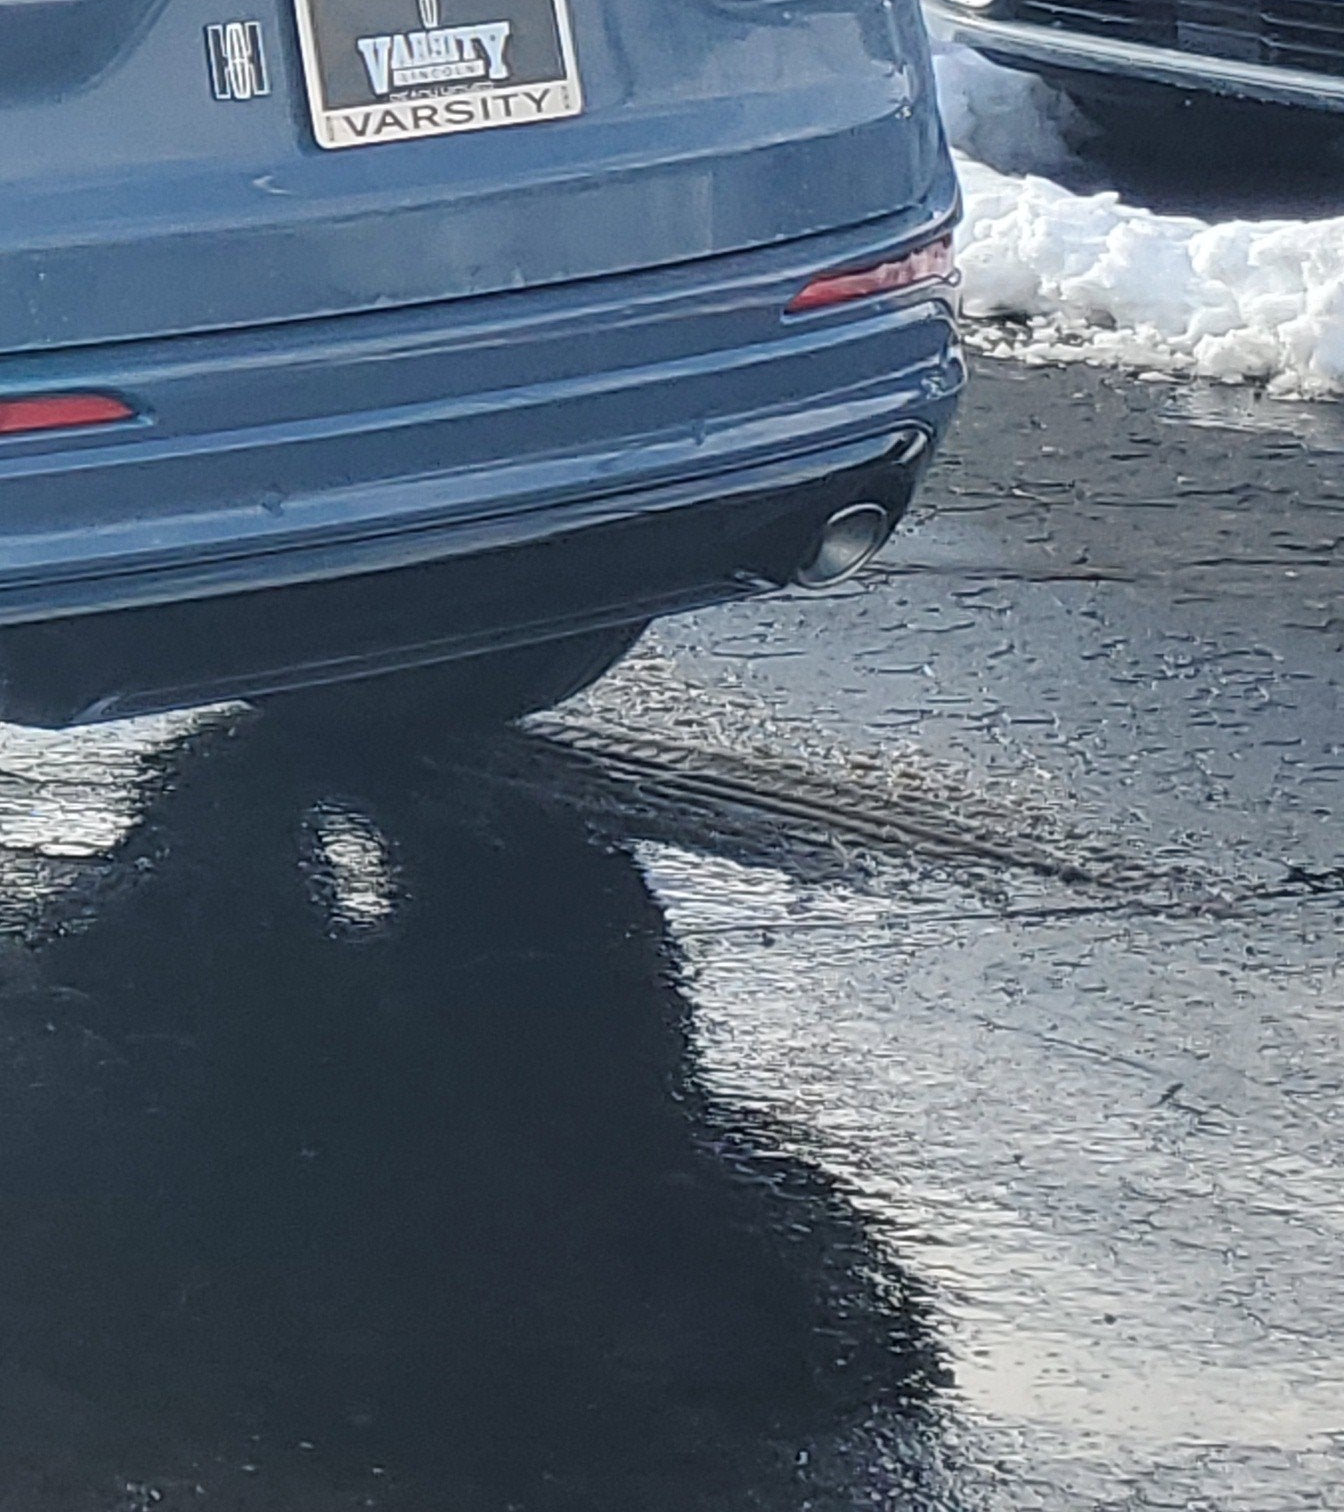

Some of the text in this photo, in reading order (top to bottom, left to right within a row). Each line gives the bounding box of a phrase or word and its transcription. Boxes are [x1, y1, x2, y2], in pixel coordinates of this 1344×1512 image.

[357, 20, 511, 95] VARSITY
[399, 63, 477, 82] LINCOLN
[343, 87, 551, 138] VARSITY
